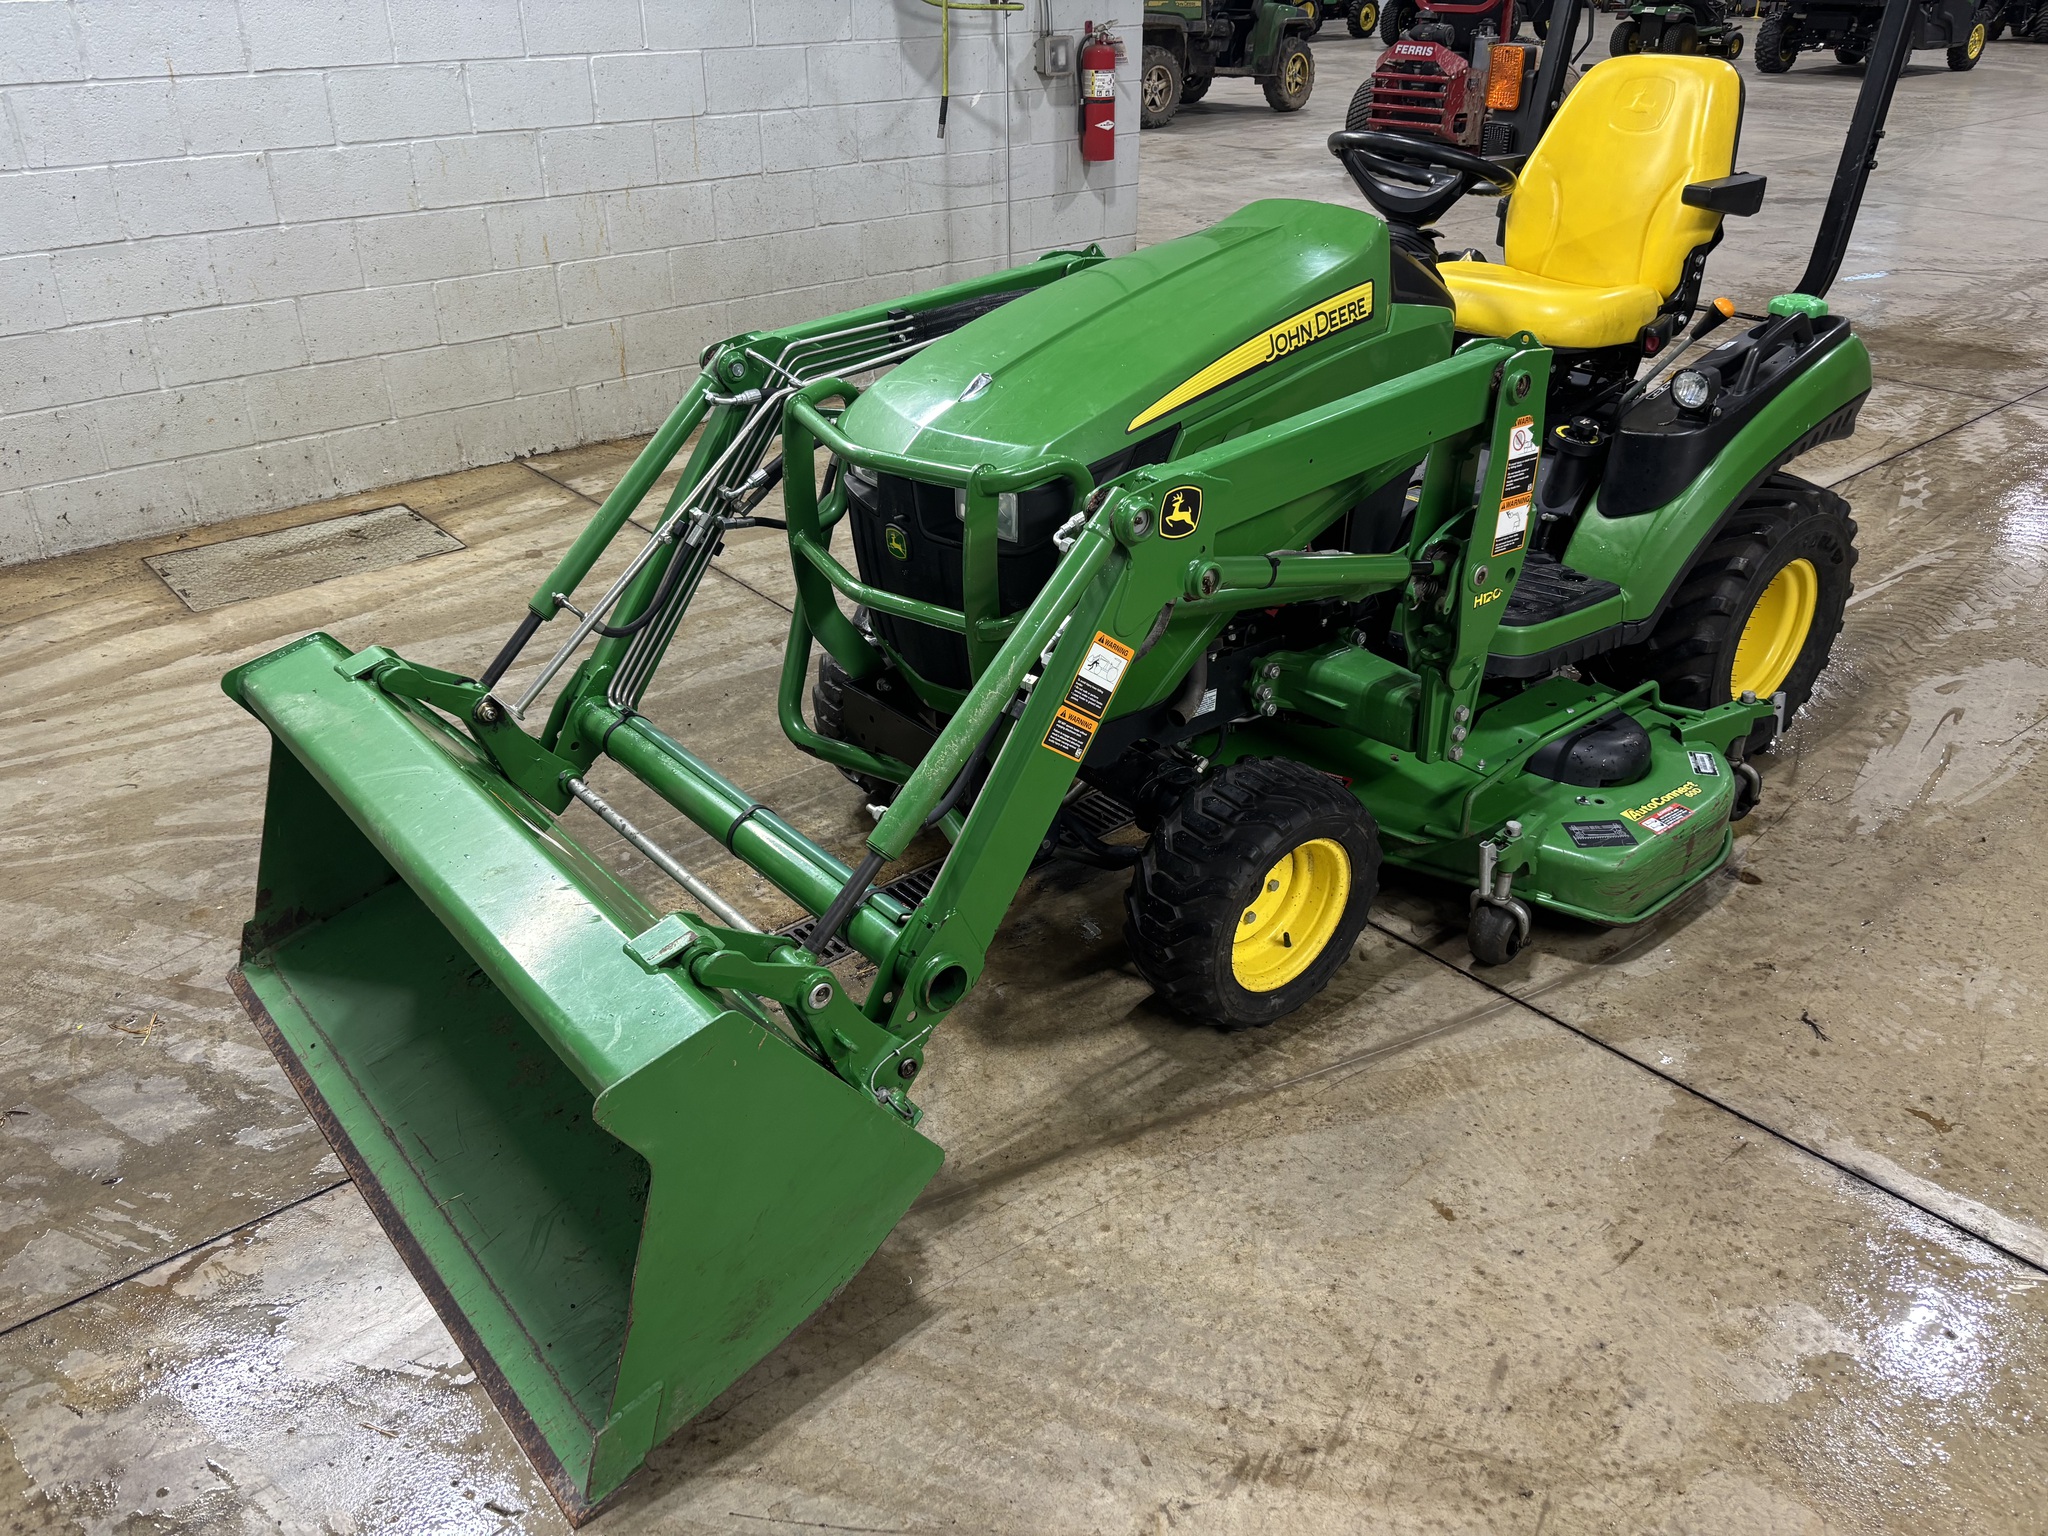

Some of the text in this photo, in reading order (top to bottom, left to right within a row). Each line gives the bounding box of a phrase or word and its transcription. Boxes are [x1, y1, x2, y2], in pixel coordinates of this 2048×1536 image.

[1394, 44, 1434, 57] FERRIS
[1265, 297, 1367, 361] JOHN DEERE
[1505, 495, 1530, 508] WARNING
[1104, 638, 1129, 657] WARNING
[1067, 713, 1093, 730] WARNING
[1629, 780, 1699, 821] AutoConnect
